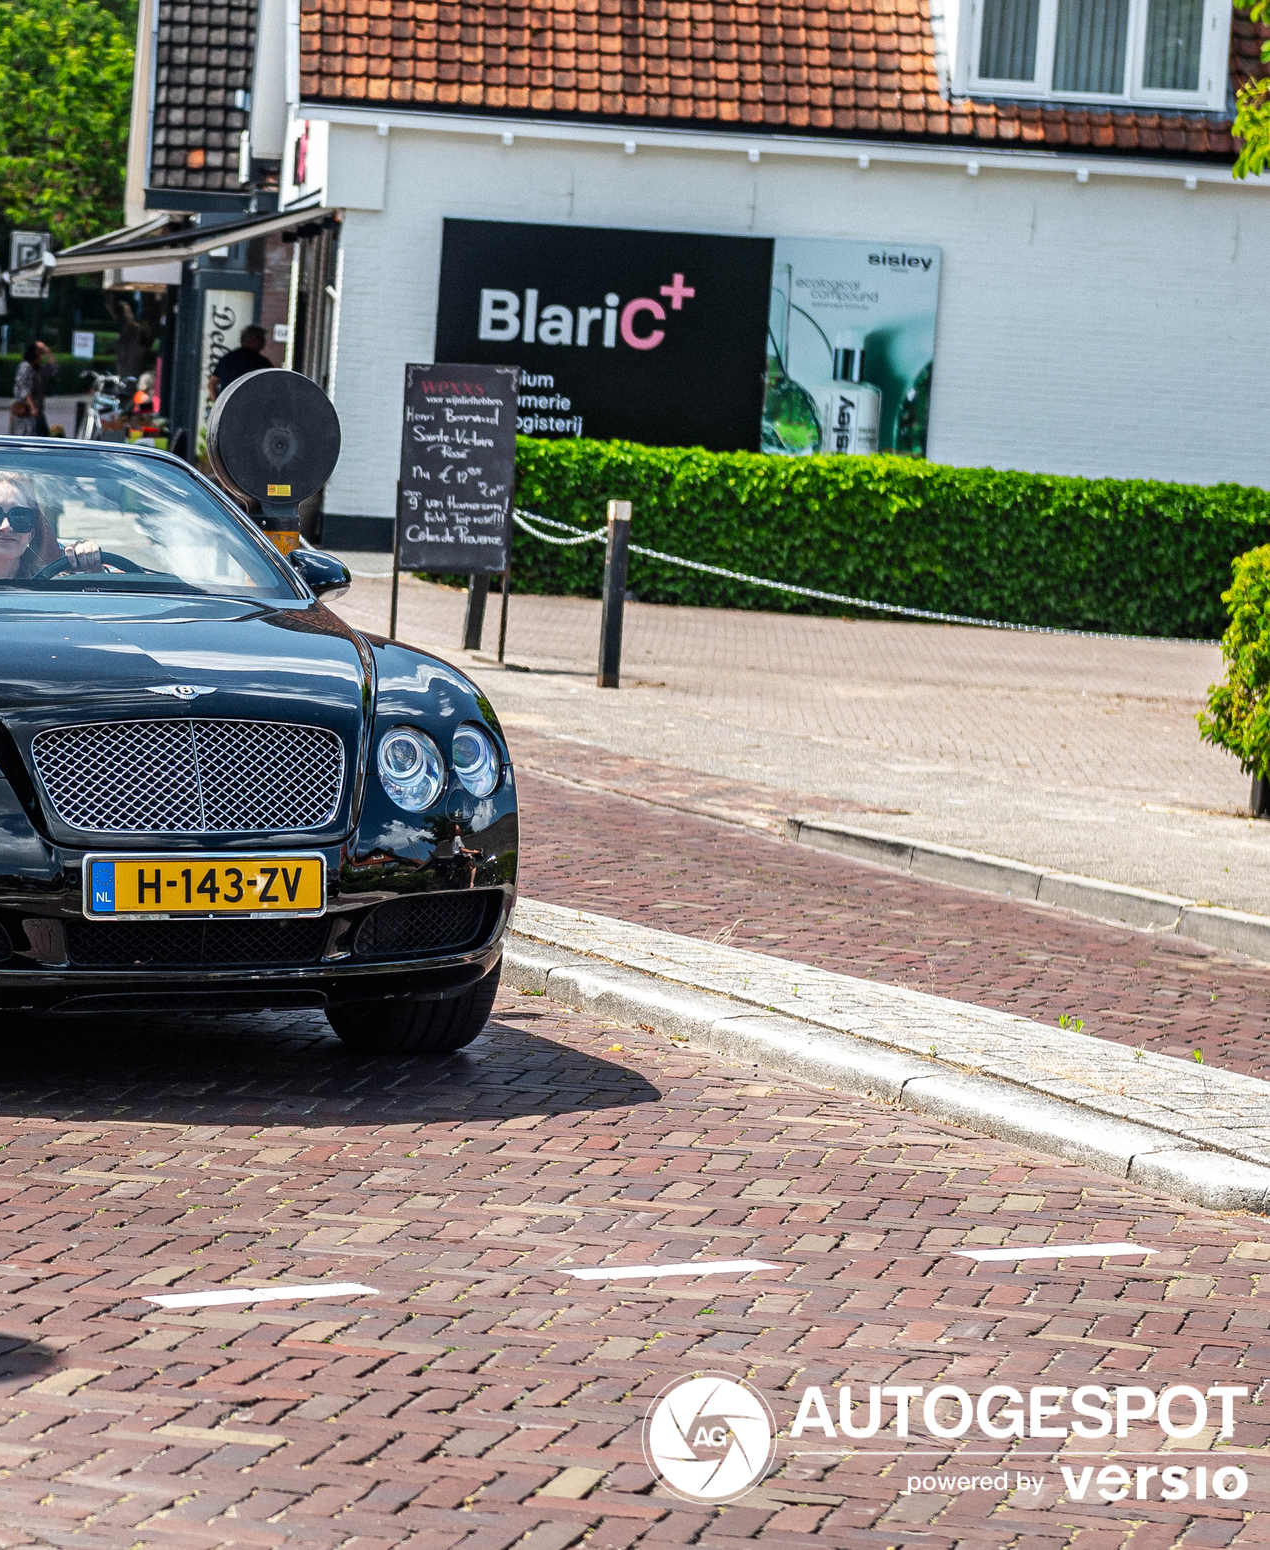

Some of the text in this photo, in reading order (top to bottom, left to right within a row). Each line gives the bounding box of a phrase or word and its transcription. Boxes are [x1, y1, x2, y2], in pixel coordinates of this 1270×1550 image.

[868, 251, 932, 272] sisley
[519, 369, 554, 388] ium
[517, 393, 571, 411] merie
[138, 867, 302, 904] H-143-ZV
[96, 891, 112, 903] NL
